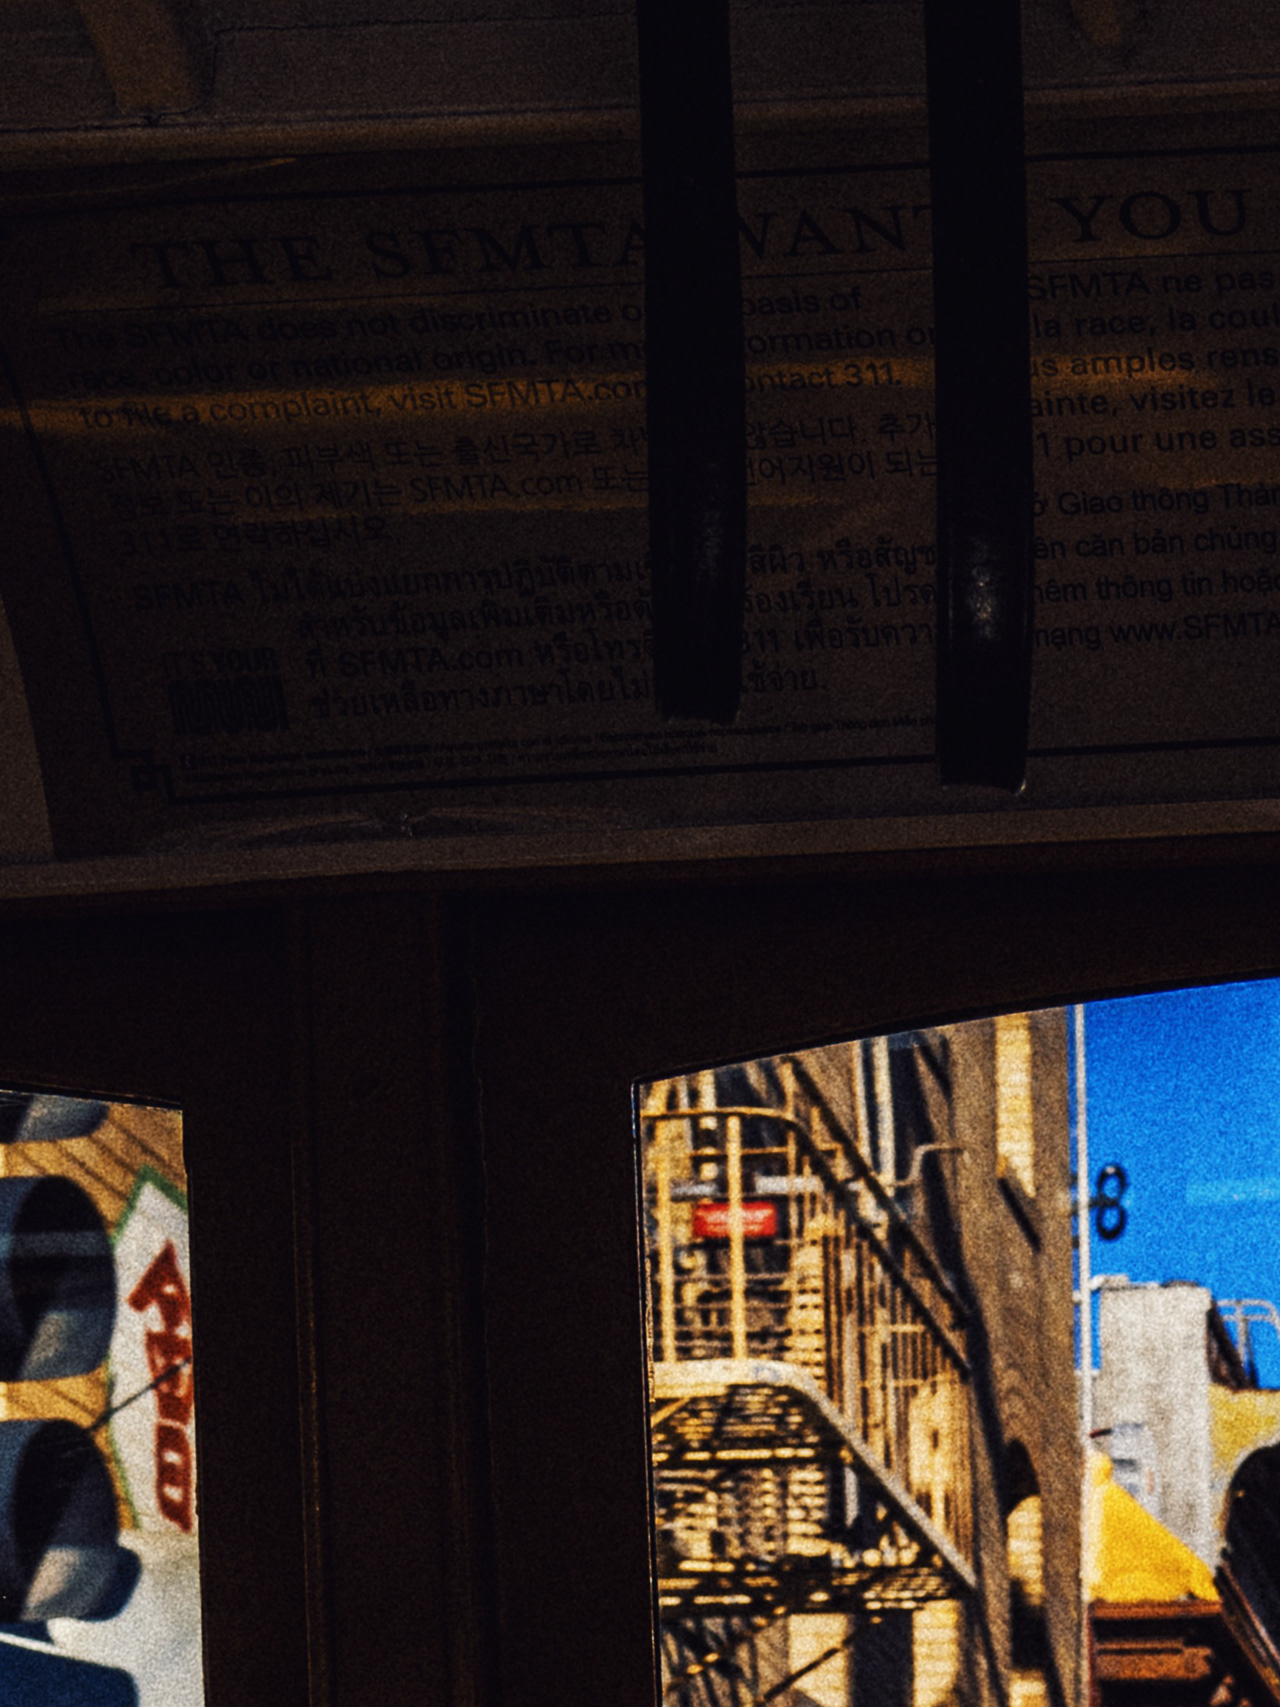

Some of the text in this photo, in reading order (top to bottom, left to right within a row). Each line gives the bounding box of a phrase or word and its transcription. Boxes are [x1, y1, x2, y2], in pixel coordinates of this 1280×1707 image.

[130, 234, 334, 292] THE
[737, 205, 934, 261] WAN
[1050, 187, 1251, 244] YOU
[1023, 269, 1151, 302] SFMTA
[1161, 273, 1202, 296] ne
[1213, 269, 1276, 300] pas
[50, 323, 118, 353] The
[124, 316, 250, 350] SFMTA
[256, 311, 337, 343] does
[347, 308, 401, 338] not
[407, 297, 612, 335] discriminate
[828, 284, 862, 312] of
[1033, 312, 1062, 340] la
[1074, 314, 1156, 346] race,
[1167, 306, 1197, 334] la
[154, 356, 236, 387] color
[246, 359, 280, 382] or
[292, 346, 423, 380] national
[430, 340, 537, 378] origin.
[543, 337, 598, 366] For
[746, 321, 896, 356] ormation
[1069, 344, 1195, 384] amples
[78, 401, 113, 430] to
[181, 403, 199, 425] a
[209, 387, 378, 429] complaint,
[388, 383, 457, 414] visit
[842, 360, 904, 390] 311.
[1030, 387, 1118, 425] ainte,
[1129, 381, 1237, 413] visitez
[1246, 379, 1276, 407] le
[96, 452, 201, 484] SFMTA
[282, 440, 376, 476] 피부색
[383, 438, 443, 471] 또는
[450, 428, 602, 468] 출신국가로
[1065, 433, 1143, 465] pour
[1154, 429, 1218, 453] une
[174, 485, 238, 520] 또는
[245, 482, 304, 516] 이의
[313, 476, 401, 512] 제기는
[409, 467, 583, 504] SFMTA.com
[591, 463, 649, 496] 또는
[1056, 488, 1123, 516] Giao
[1130, 484, 1209, 519] thông
[118, 513, 401, 560] 311로 연락하십시오.
[1073, 532, 1125, 559] căn
[1132, 529, 1186, 556] bản
[1192, 525, 1278, 559] chủng
[130, 578, 248, 612] SFMTA
[1096, 573, 1173, 606] thông
[1181, 571, 1213, 596] tin
[337, 640, 525, 678] SFMTA.com
